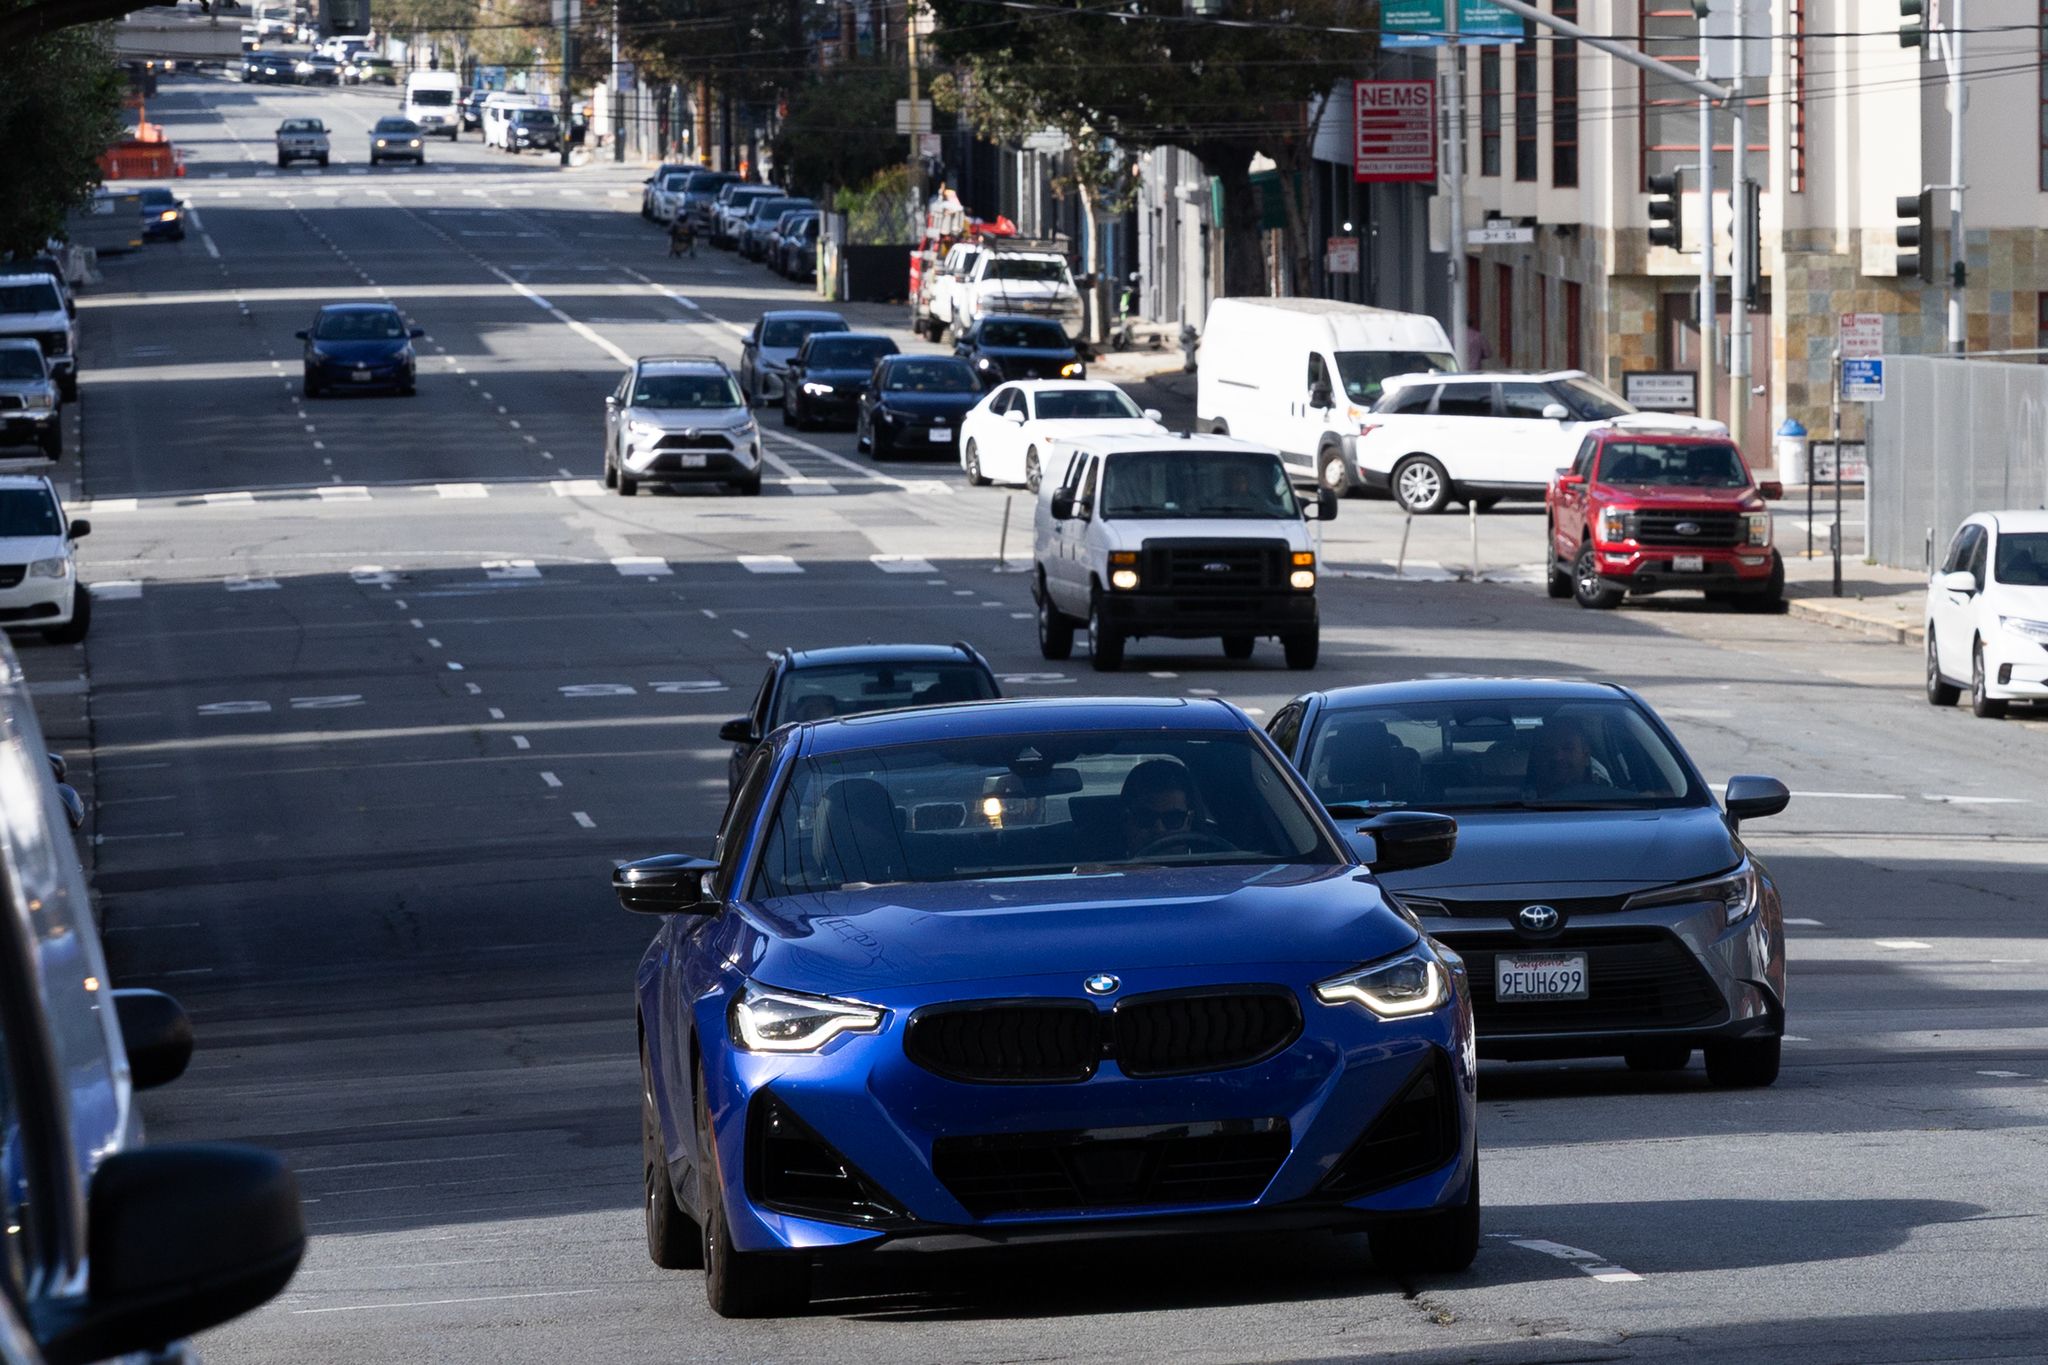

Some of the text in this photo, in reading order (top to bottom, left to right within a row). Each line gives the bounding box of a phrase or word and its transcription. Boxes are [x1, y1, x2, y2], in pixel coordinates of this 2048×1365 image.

[1361, 87, 1428, 106] NEMS
[1514, 959, 1565, 971] California
[1502, 970, 1582, 994] 9EUH699
